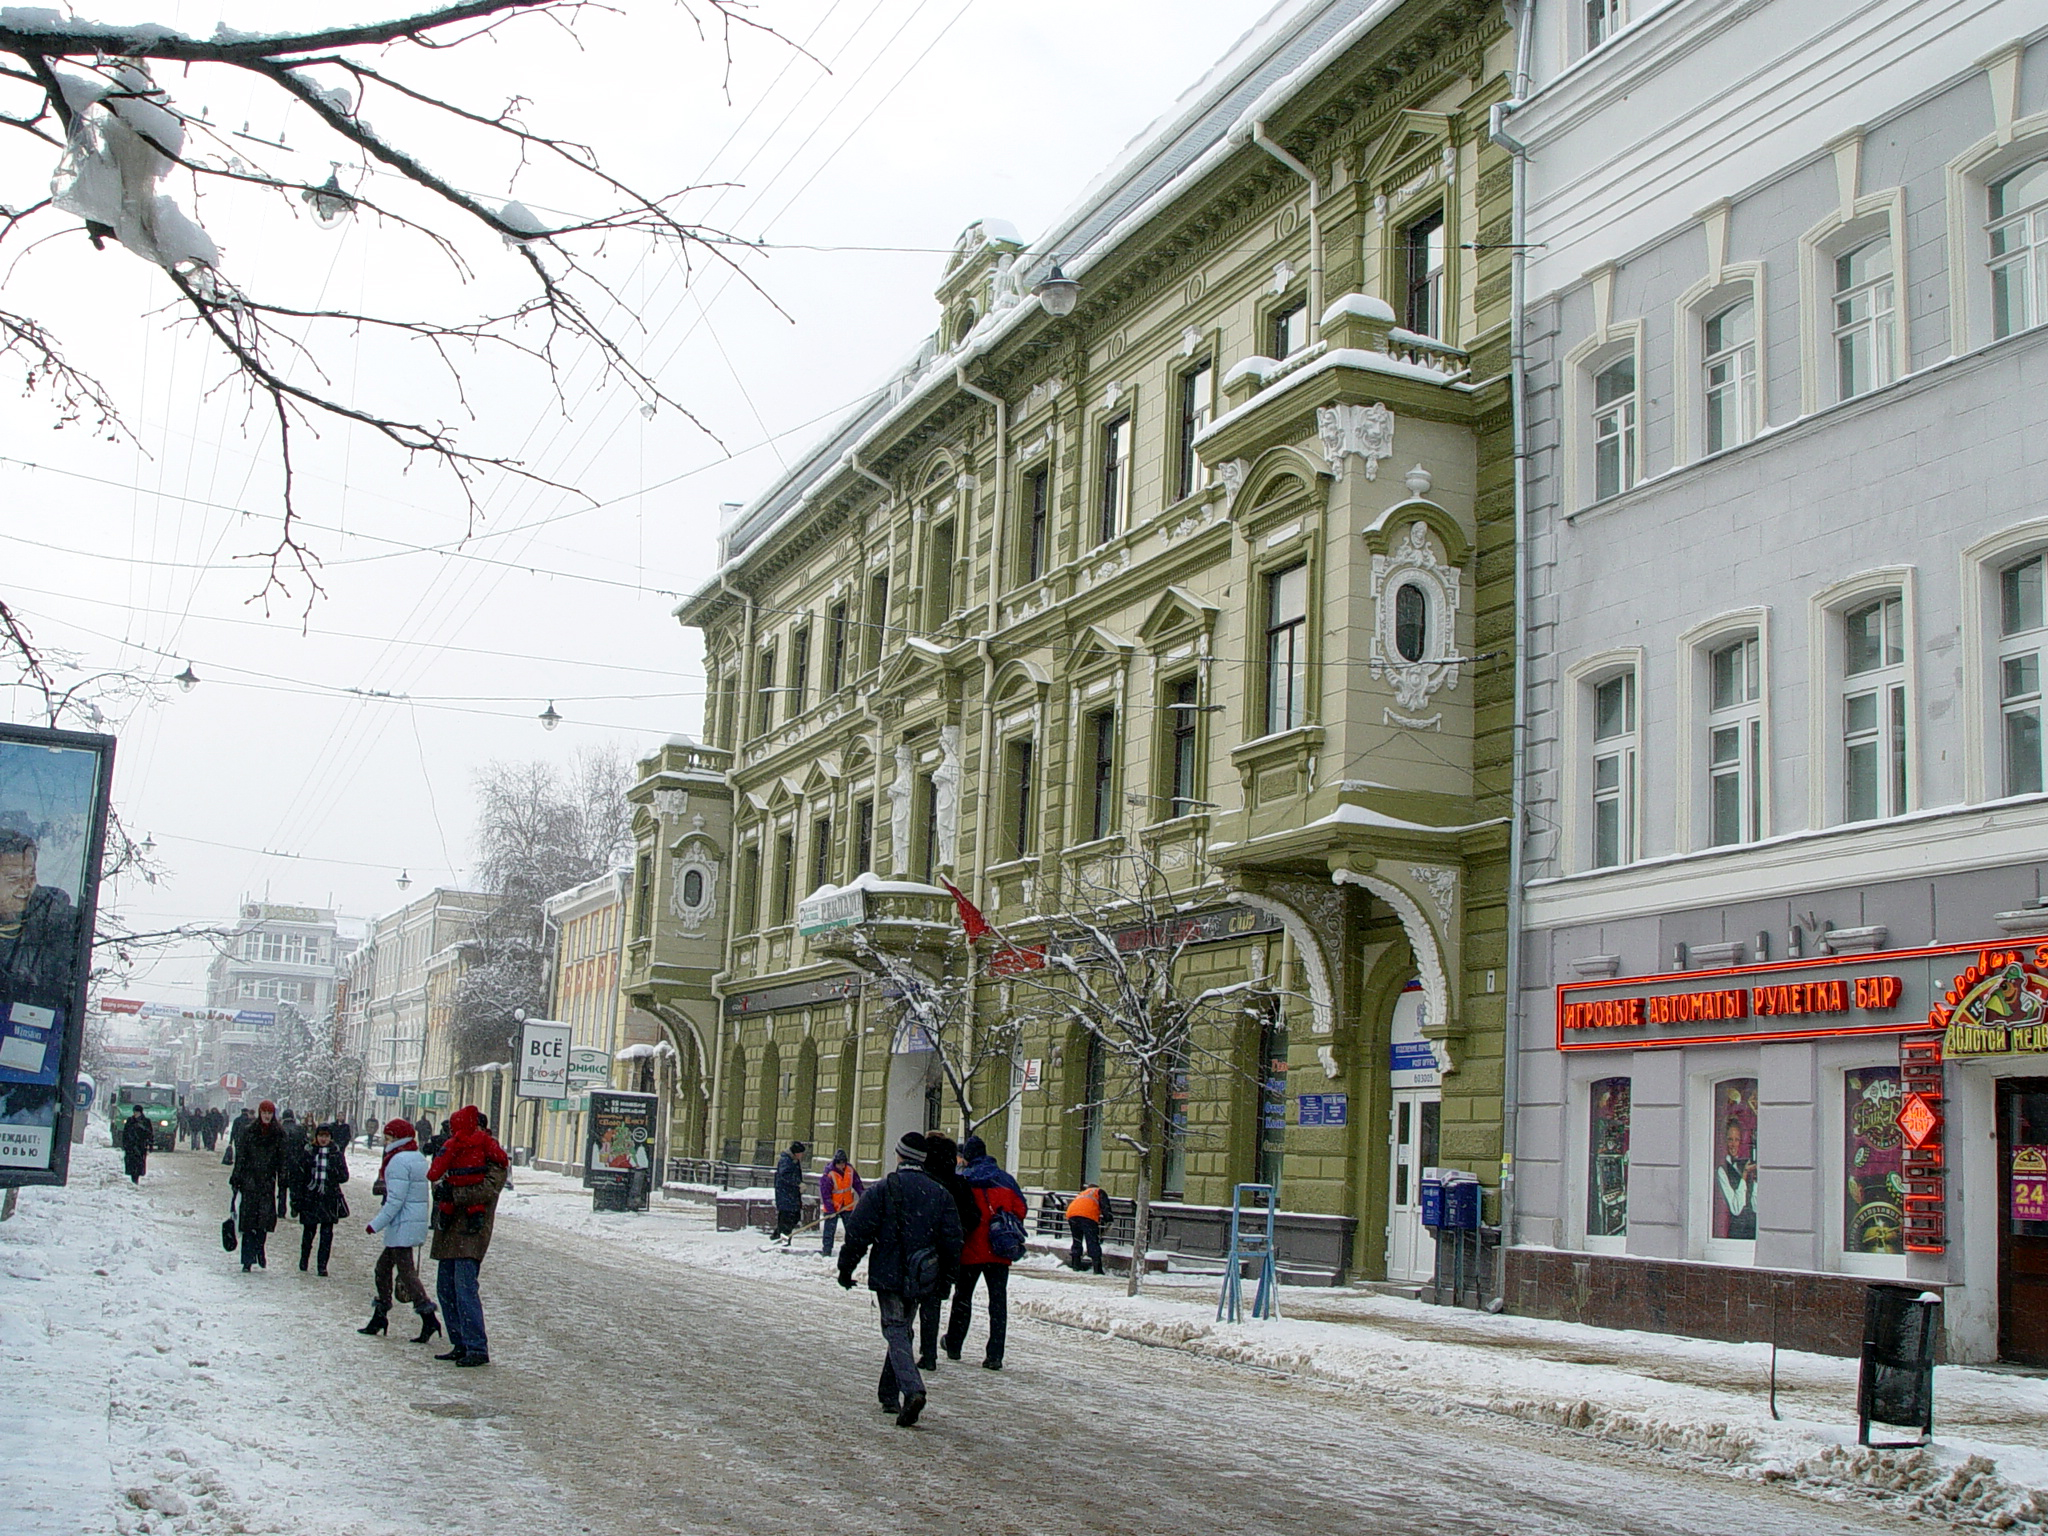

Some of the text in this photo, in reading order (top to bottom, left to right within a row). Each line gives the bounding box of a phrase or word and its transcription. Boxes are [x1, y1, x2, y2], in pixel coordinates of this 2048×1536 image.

[1488, 974, 1494, 989] 7
[1565, 975, 1903, 1029] ИГРОВЫЕ АВТОМАТЫ РУЛЕТКА БАР
[14, 1025, 42, 1039] Winston
[1947, 1024, 2008, 1054] ЗОЛОТОЙ
[531, 1038, 562, 1058] ВСЁ
[568, 1062, 607, 1075] ОНИКС
[2015, 1183, 2045, 1206] 24
[2018, 1206, 2042, 1215] ЧАСА
